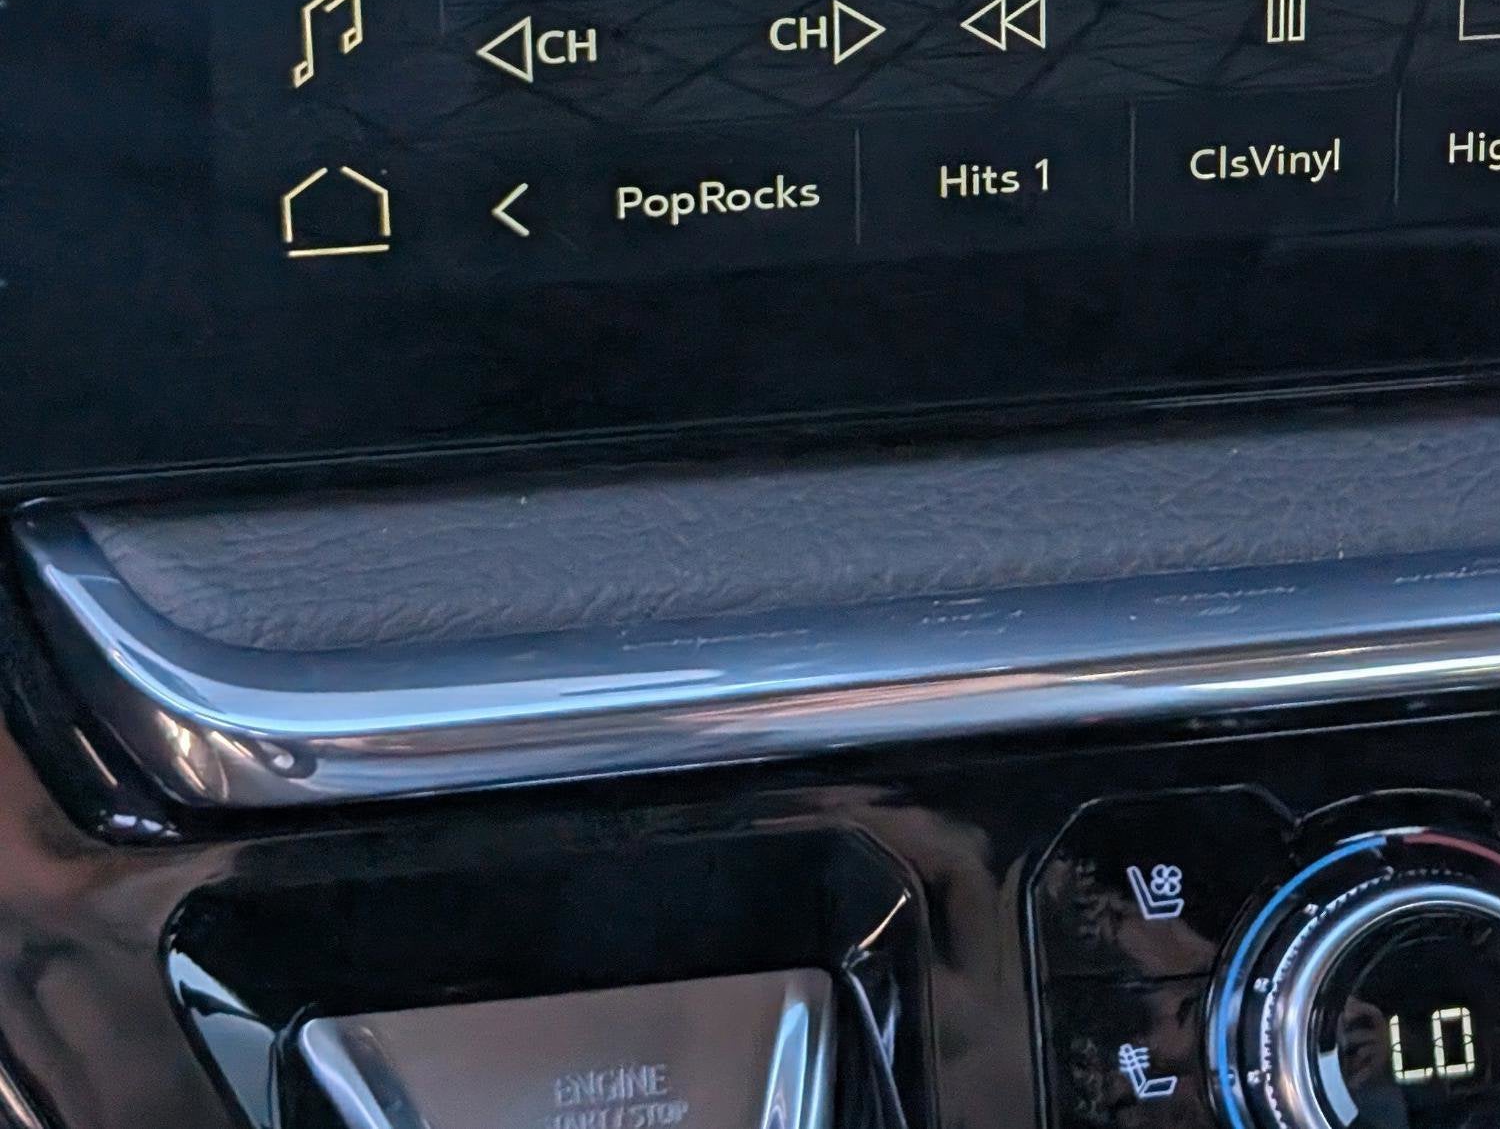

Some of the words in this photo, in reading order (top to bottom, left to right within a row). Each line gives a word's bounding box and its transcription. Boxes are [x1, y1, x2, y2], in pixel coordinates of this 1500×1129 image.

[536, 28, 597, 65] CH
[769, 15, 828, 51] CH
[940, 163, 1020, 199] Hits
[1035, 158, 1049, 191] 1
[1190, 137, 1341, 183] ClsVinyl
[617, 174, 820, 226] PopRocks
[553, 1063, 671, 1105] ENGINE
